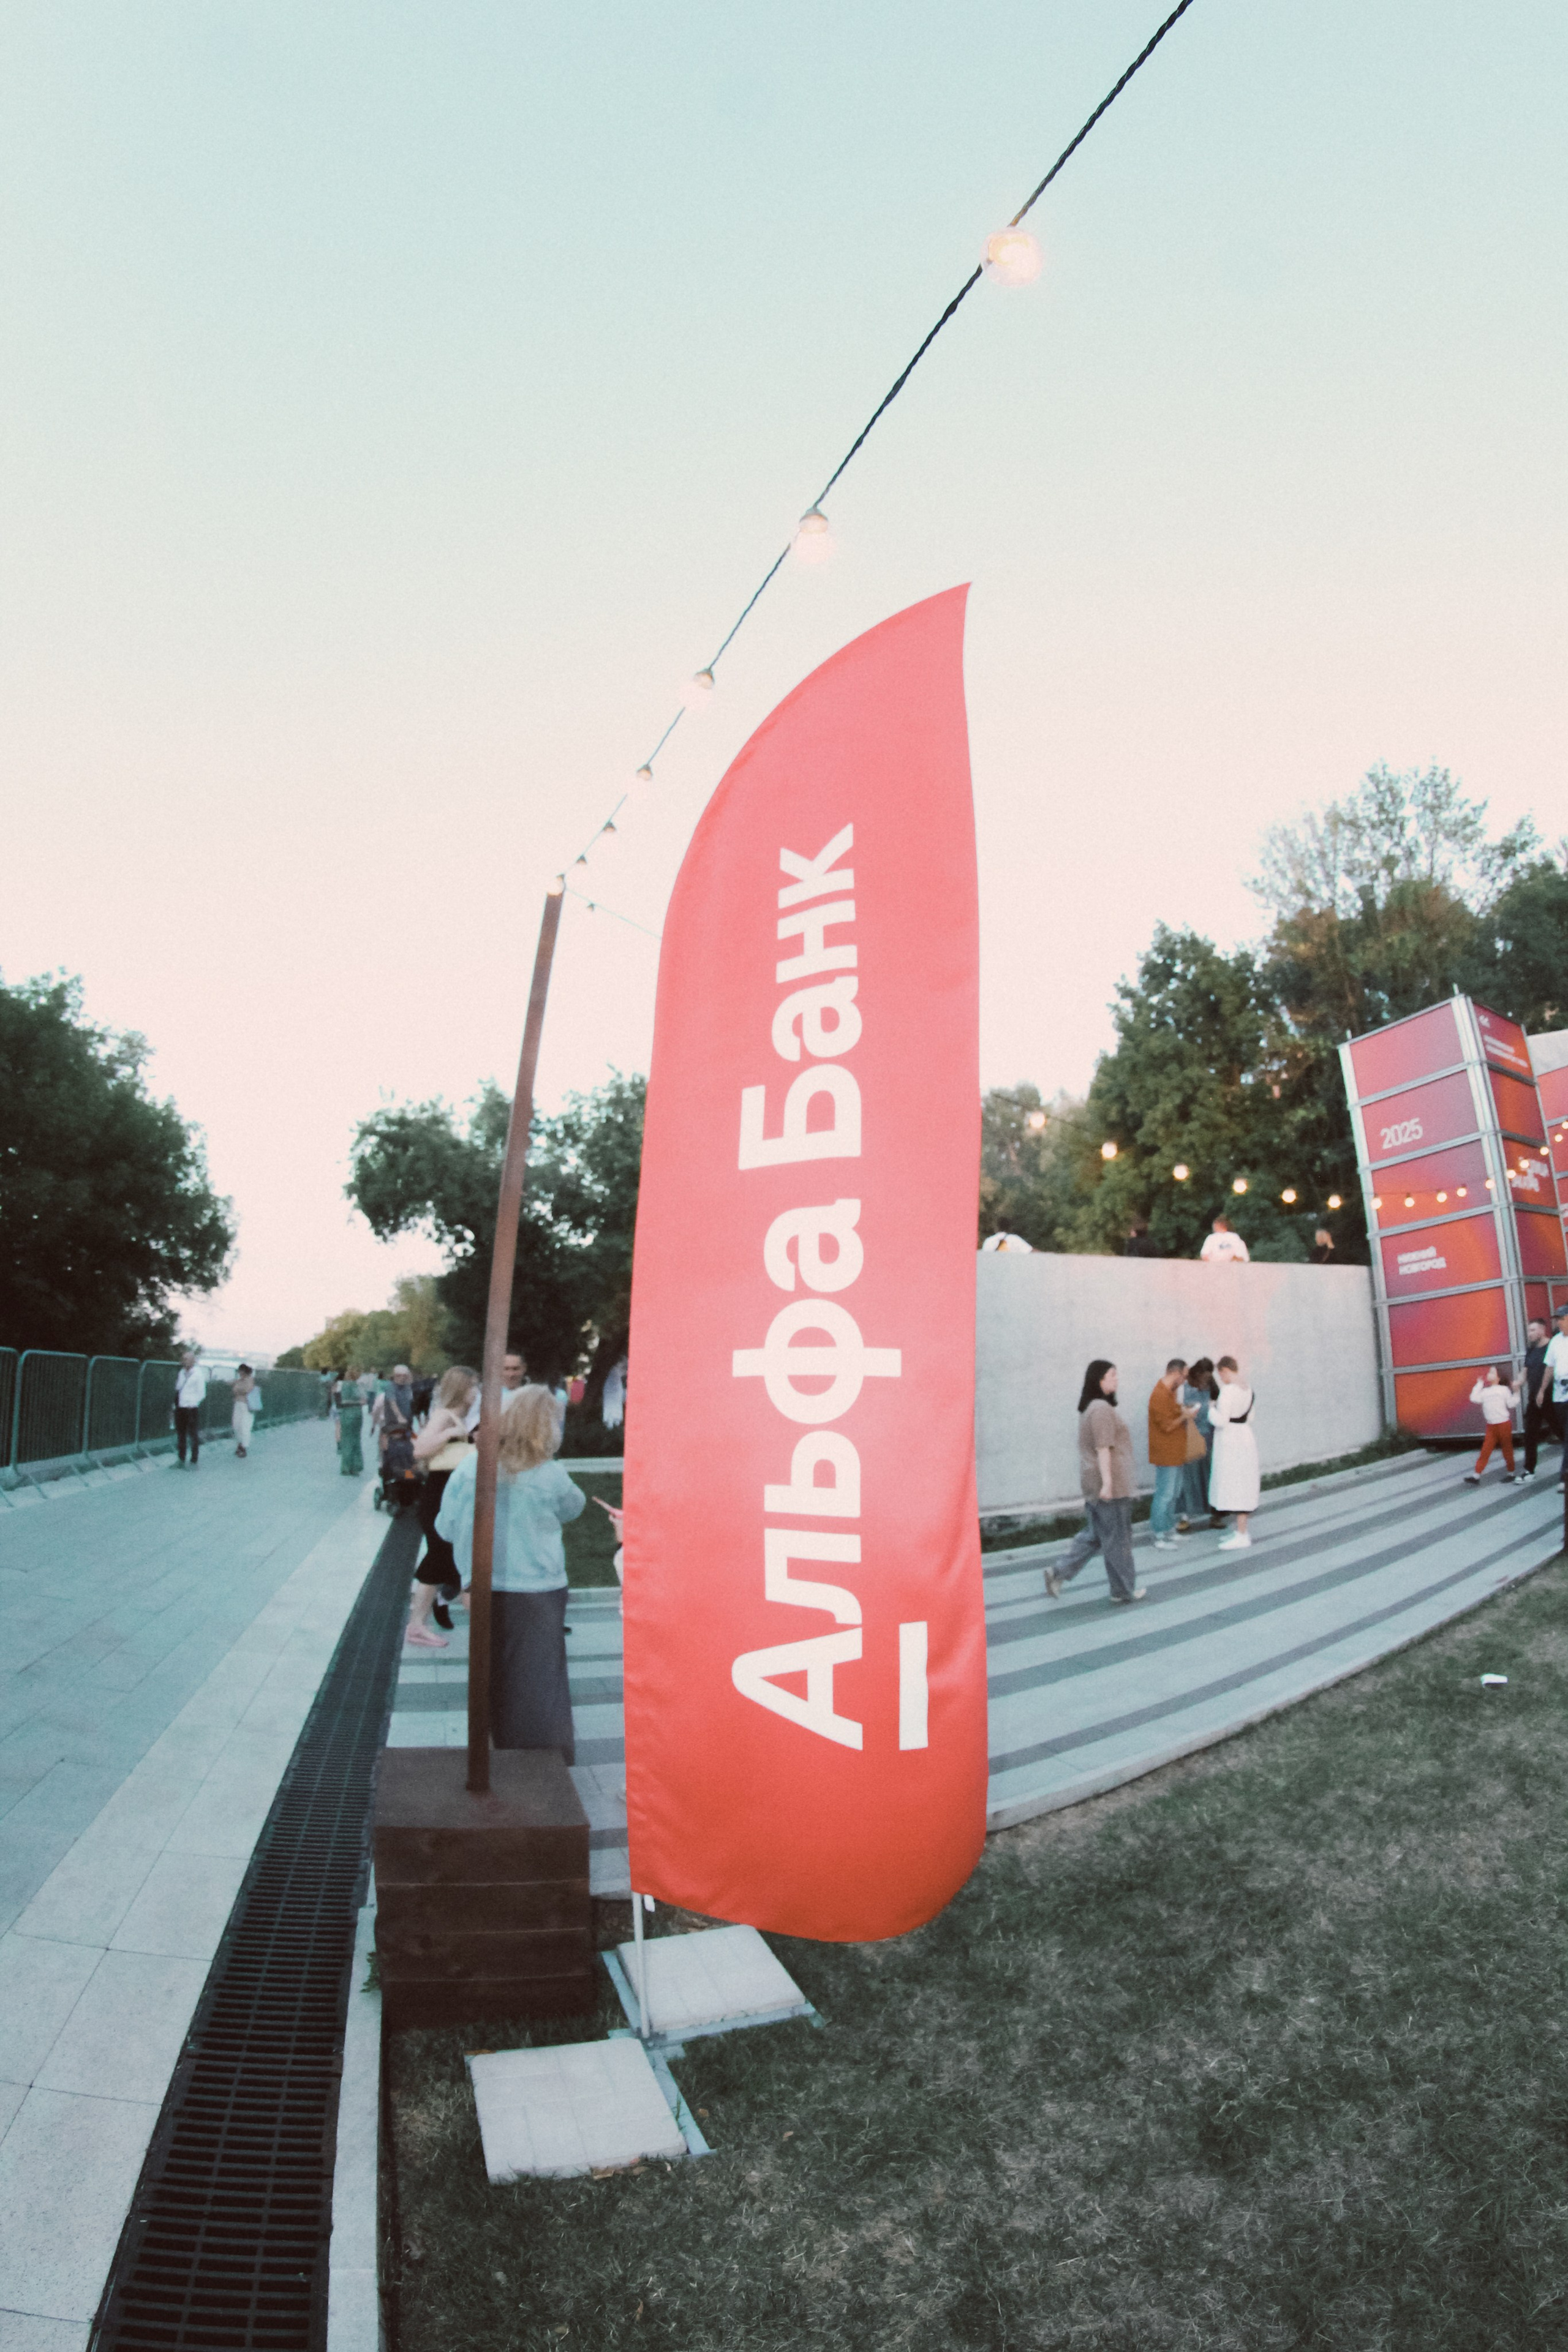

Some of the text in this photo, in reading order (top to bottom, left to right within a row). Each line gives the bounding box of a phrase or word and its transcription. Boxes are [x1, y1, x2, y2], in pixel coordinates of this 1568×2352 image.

[731, 823, 902, 1750] Альфа Банк
[1380, 1117, 1423, 1149] 2025
